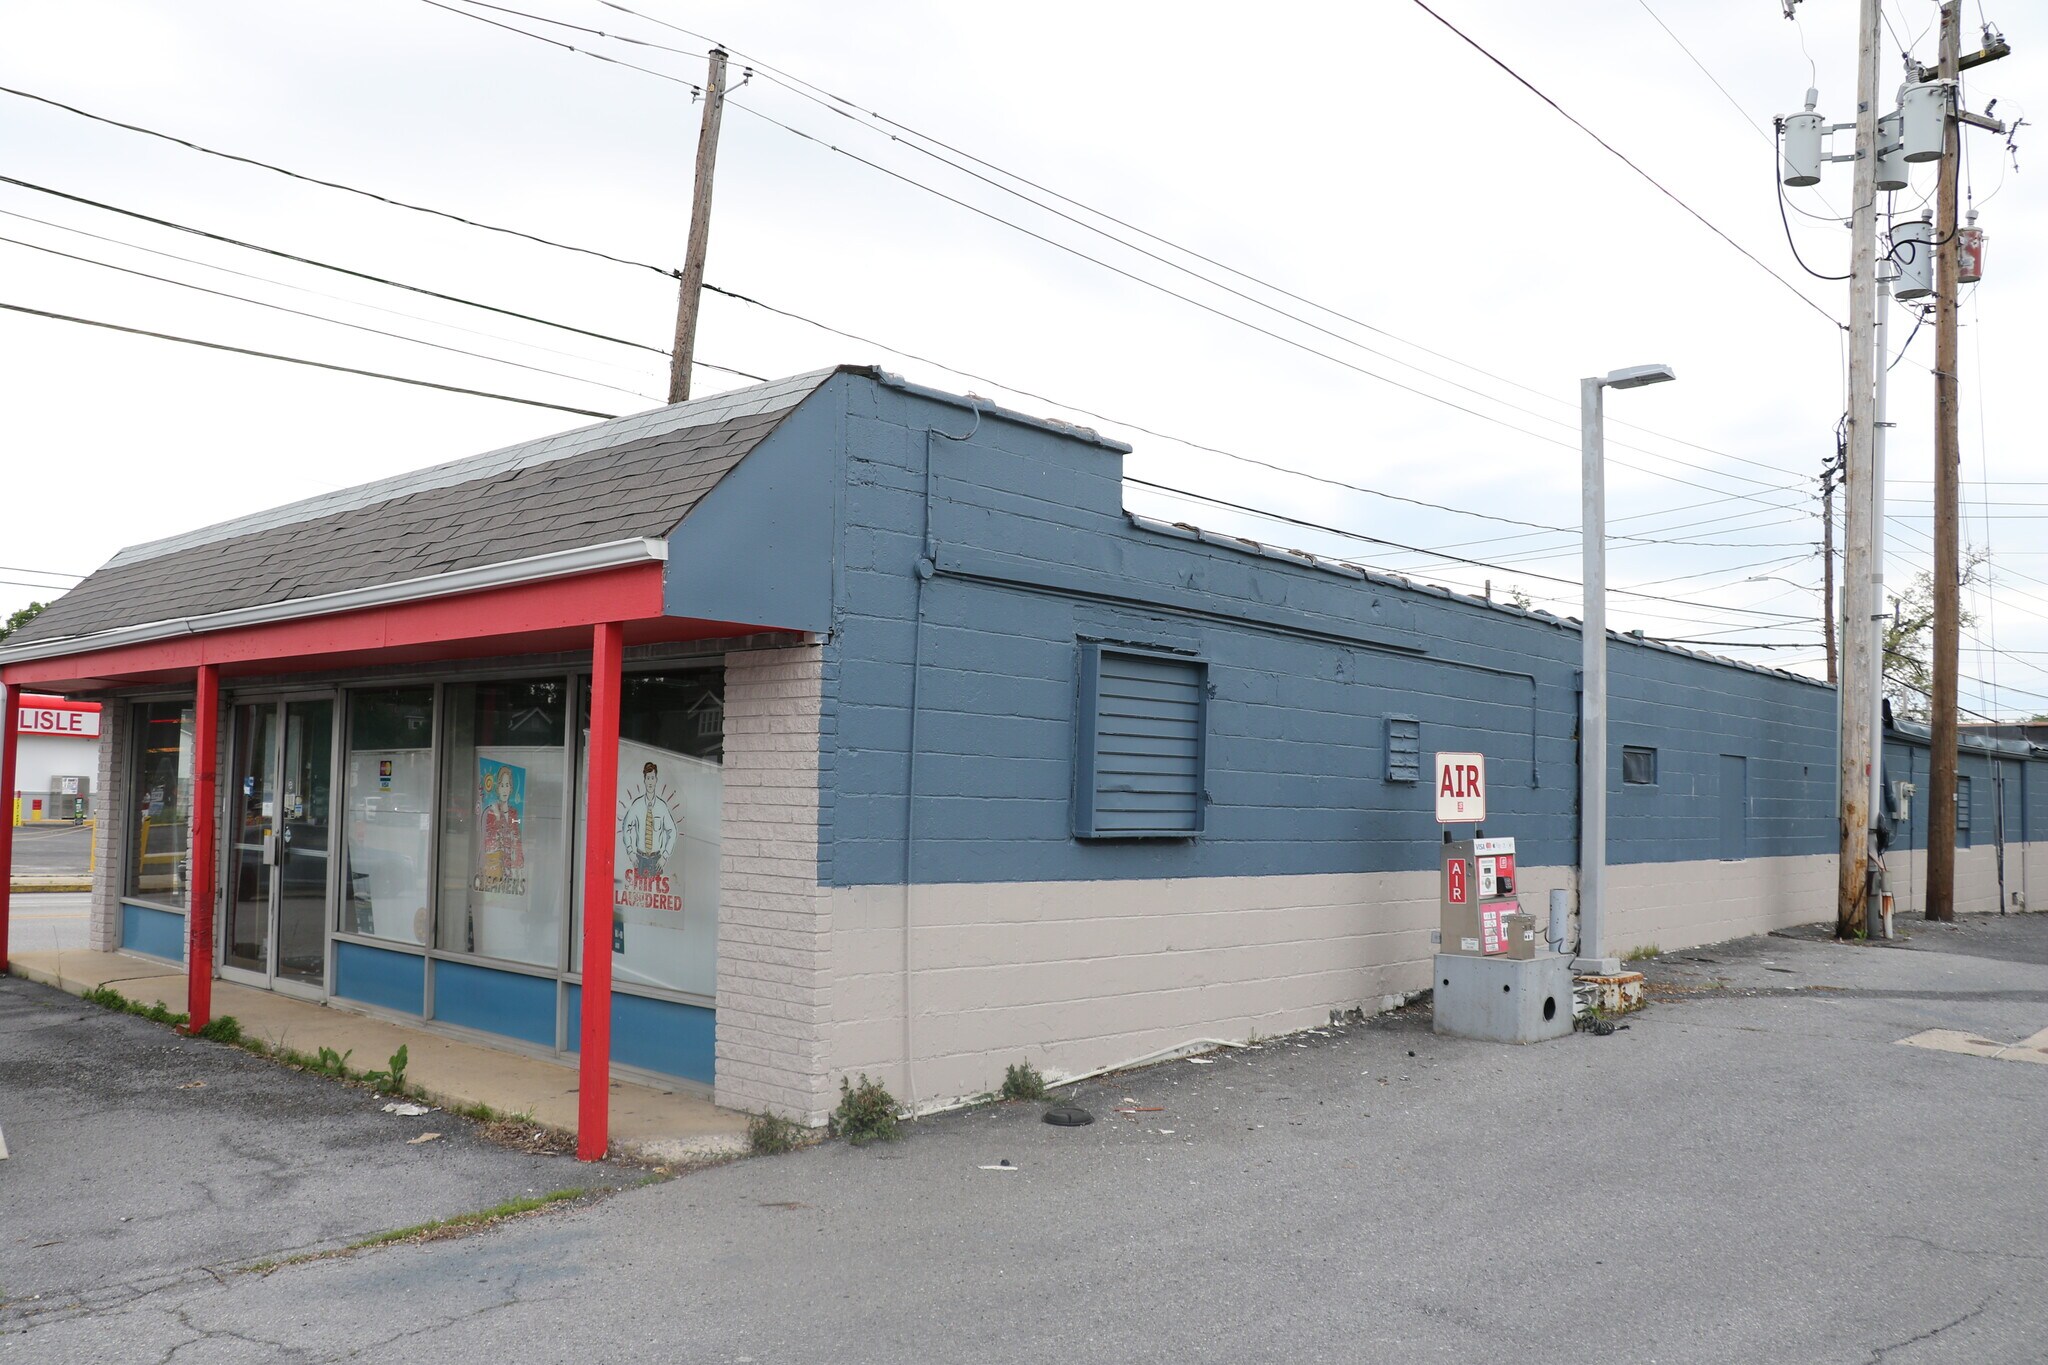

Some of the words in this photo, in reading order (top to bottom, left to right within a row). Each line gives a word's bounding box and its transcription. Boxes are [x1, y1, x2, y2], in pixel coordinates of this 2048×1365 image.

[20, 710, 83, 731] LISLE
[1440, 764, 1481, 797] AIR
[1452, 862, 1462, 900] AIR
